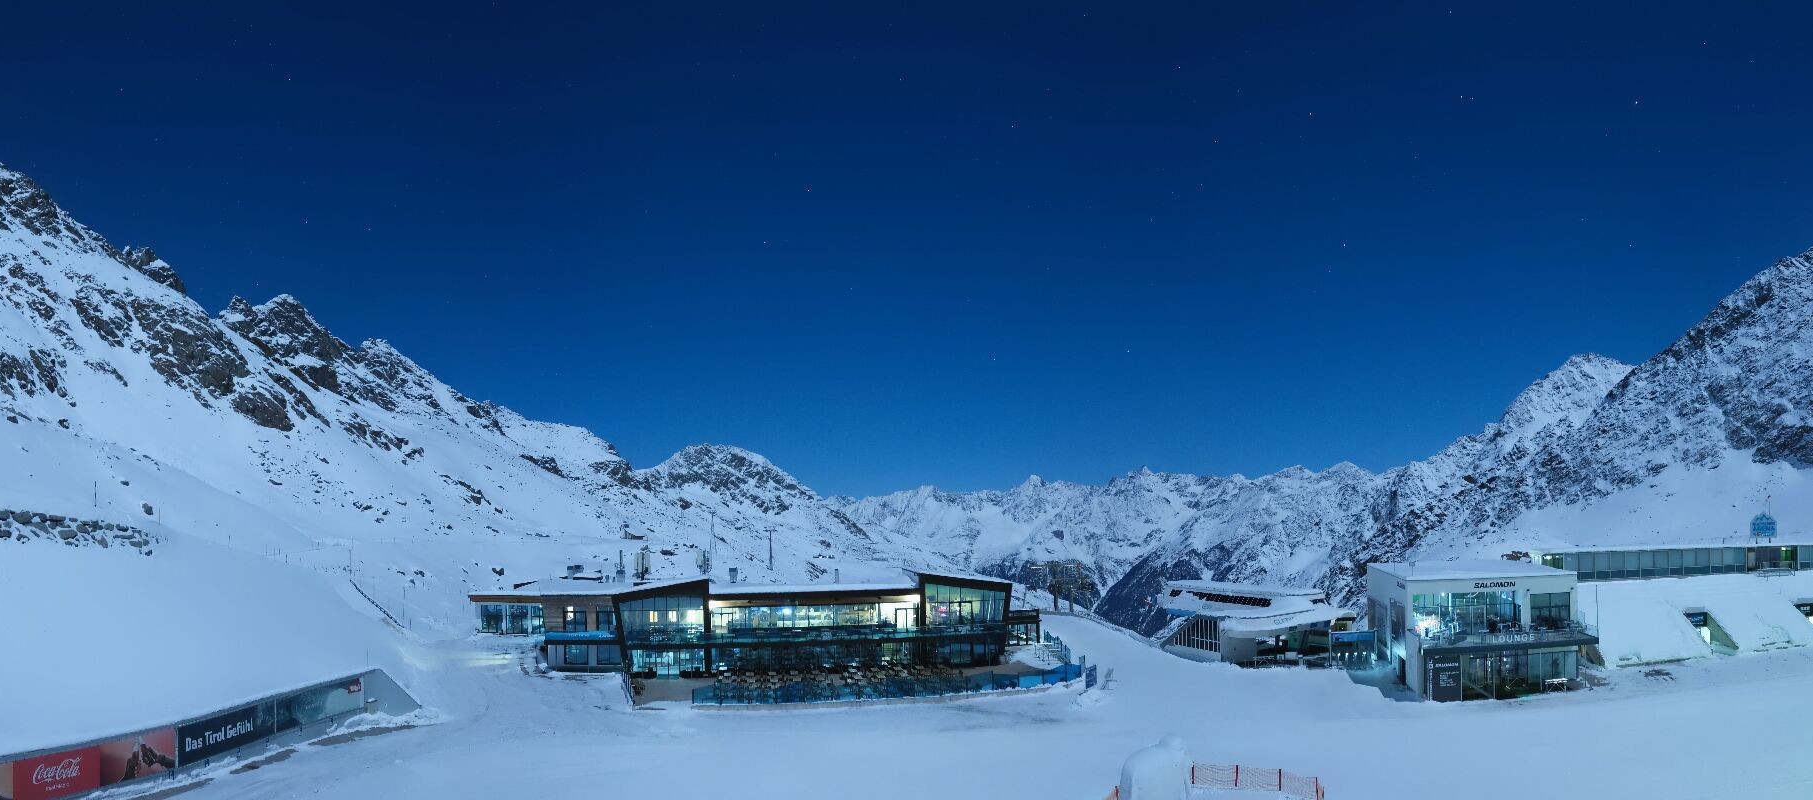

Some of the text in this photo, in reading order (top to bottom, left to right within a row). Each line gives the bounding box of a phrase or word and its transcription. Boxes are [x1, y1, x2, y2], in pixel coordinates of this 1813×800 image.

[1474, 581, 1516, 589] SALOMON
[1492, 633, 1535, 643] LOUNGE
[185, 717, 254, 752] Das Tirol Gefühl
[32, 756, 82, 785] Coca-Cola
